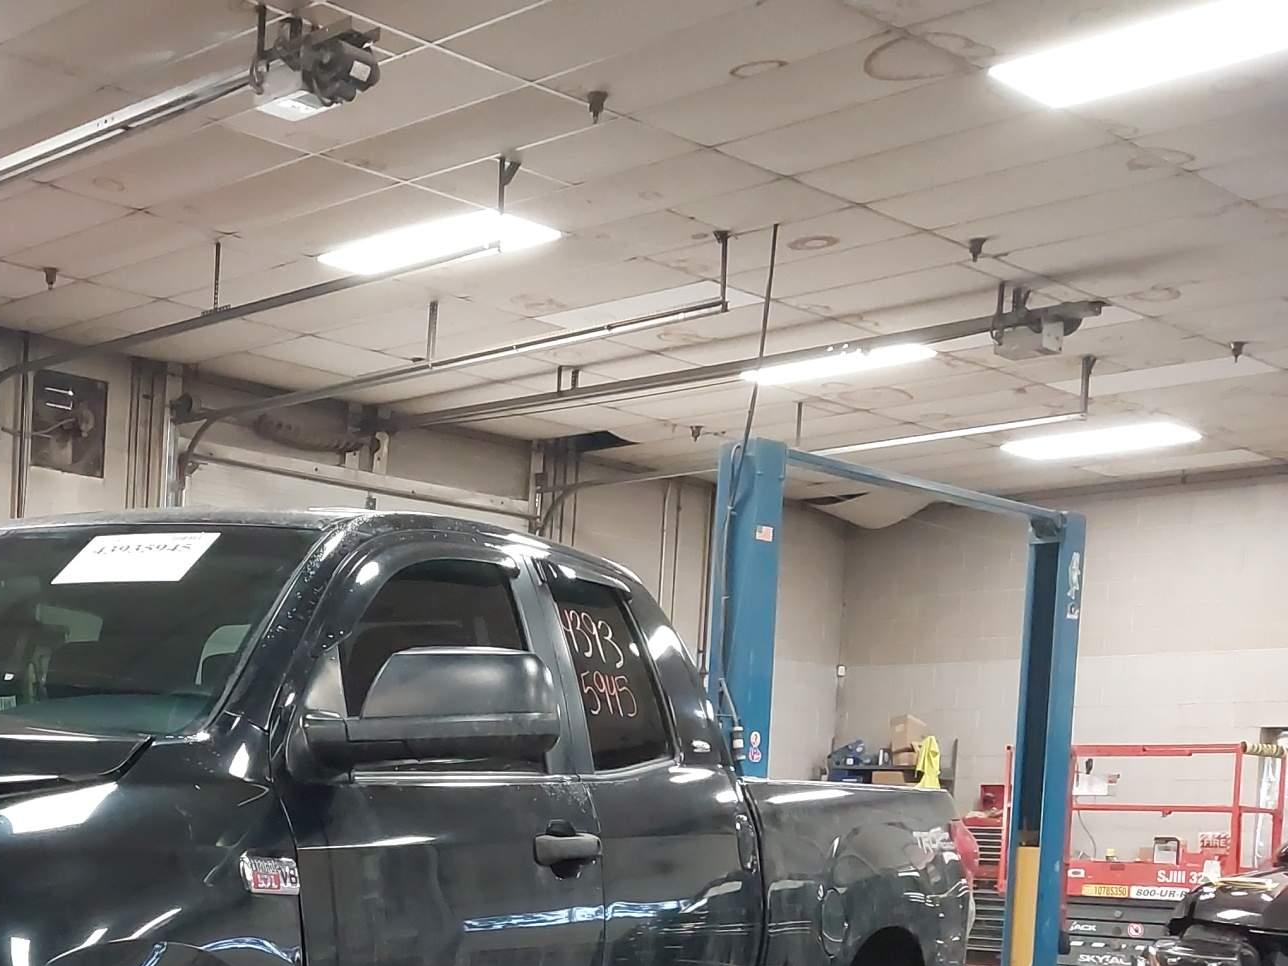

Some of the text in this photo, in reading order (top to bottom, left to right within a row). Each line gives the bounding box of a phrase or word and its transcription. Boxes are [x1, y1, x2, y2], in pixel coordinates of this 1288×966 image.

[562, 609, 624, 669] 4393
[580, 670, 638, 718] 5945
[1205, 838, 1227, 848] FIRE
